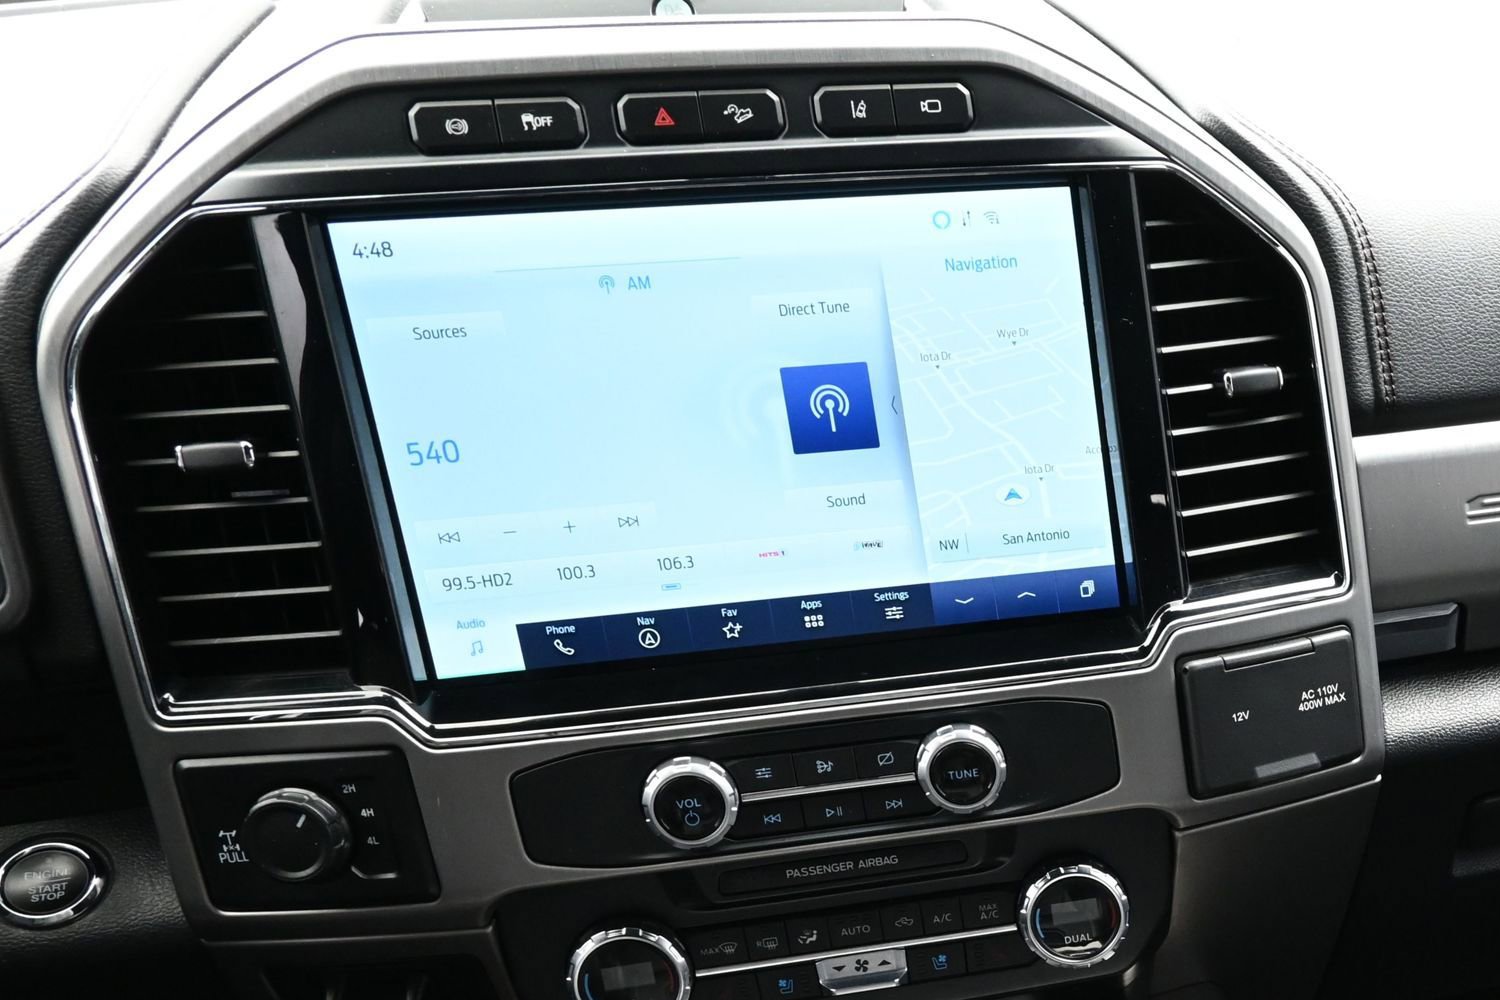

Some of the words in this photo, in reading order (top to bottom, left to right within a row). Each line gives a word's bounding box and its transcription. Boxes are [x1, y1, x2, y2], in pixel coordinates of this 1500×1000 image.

[534, 115, 553, 127] OFF
[352, 241, 394, 259] 4:48
[944, 255, 1018, 272] Navigation
[626, 275, 652, 290] AM
[779, 302, 816, 317] Direct
[818, 301, 850, 315] Tune
[412, 325, 467, 341] Sources
[996, 328, 1016, 341] Wye
[1018, 327, 1029, 338] Dr
[406, 439, 461, 467] 540
[826, 493, 866, 508] Sound
[1002, 533, 1024, 546] San
[1026, 529, 1070, 544] Antonio
[939, 539, 960, 551] NW
[656, 555, 695, 571] 106.3
[556, 565, 596, 581] 100.3
[442, 572, 513, 592] 99.5-HD2
[874, 590, 910, 602] Settings
[800, 599, 822, 611] Apps
[721, 607, 738, 618] Fav
[456, 618, 486, 630] Audio
[637, 615, 655, 627] Nav
[546, 623, 576, 636] Phone
[1301, 689, 1316, 700] AC
[1317, 683, 1339, 697] 110V
[1298, 700, 1324, 712] 400W
[1325, 692, 1347, 706] MAX
[1231, 710, 1250, 722] 12V
[948, 767, 980, 780] TUNE
[341, 784, 357, 794] 2H
[675, 799, 702, 810] VOL
[360, 808, 375, 818] 4H
[367, 836, 381, 846] 4L
[218, 852, 250, 864] PULL
[786, 860, 854, 879] PASSENGER
[858, 855, 899, 870] AIRBAG
[28, 882, 68, 894] START
[31, 891, 65, 903] STOP
[979, 902, 998, 913] MAX
[932, 912, 953, 924] A/C
[979, 908, 1000, 921] A/C
[840, 924, 871, 936] AUTO
[1063, 932, 1094, 945] DUAL
[699, 945, 721, 955] MAX
